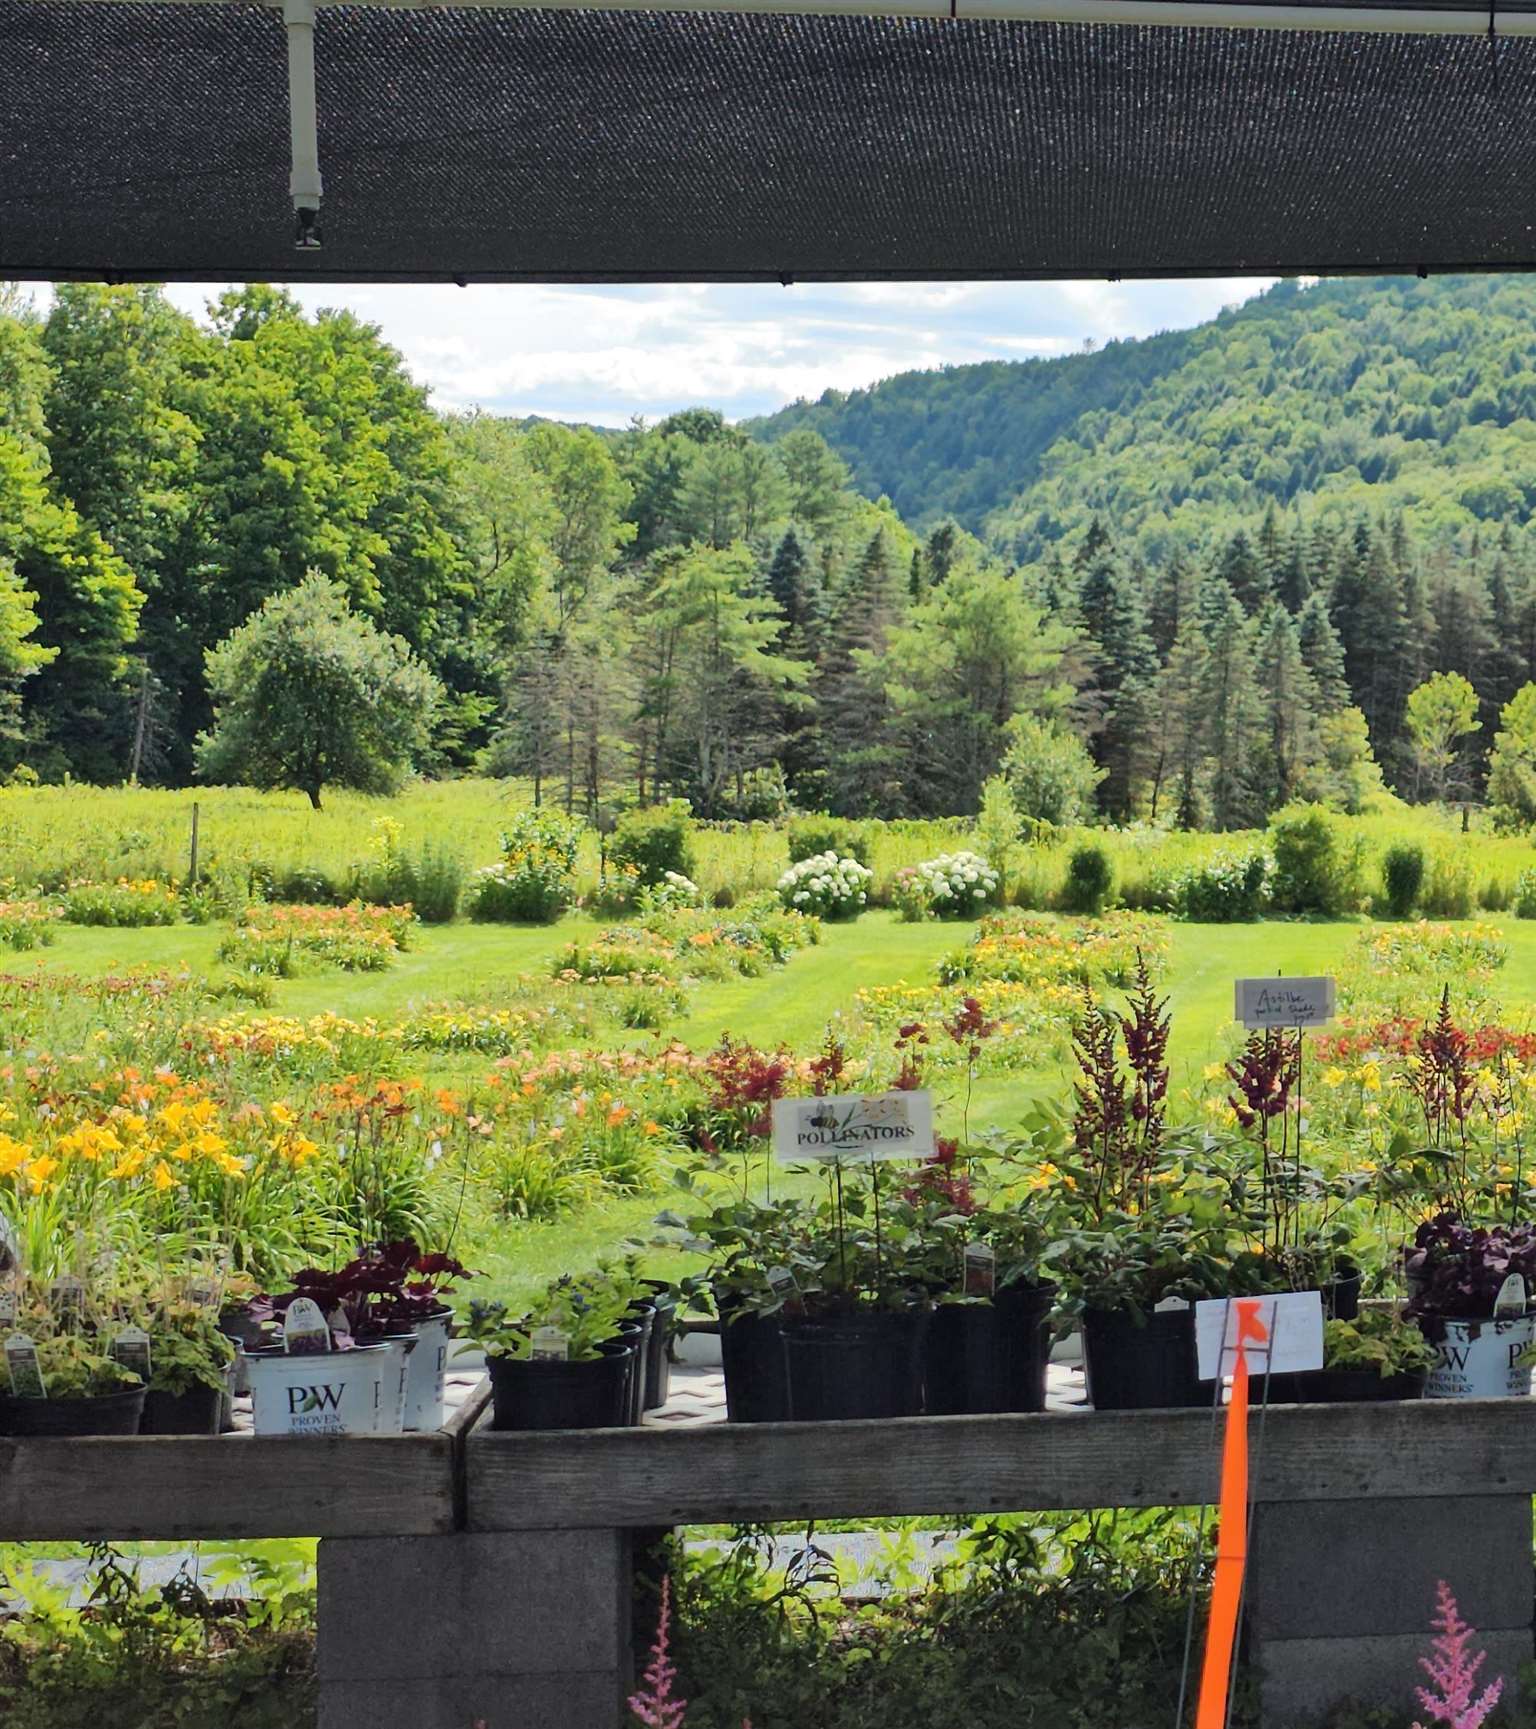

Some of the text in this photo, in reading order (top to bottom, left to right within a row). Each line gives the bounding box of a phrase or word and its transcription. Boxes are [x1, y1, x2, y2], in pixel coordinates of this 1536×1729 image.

[797, 1126, 915, 1145] POLLINATORS
[286, 1382, 347, 1414] PW
[290, 1413, 342, 1427] PROVEN
